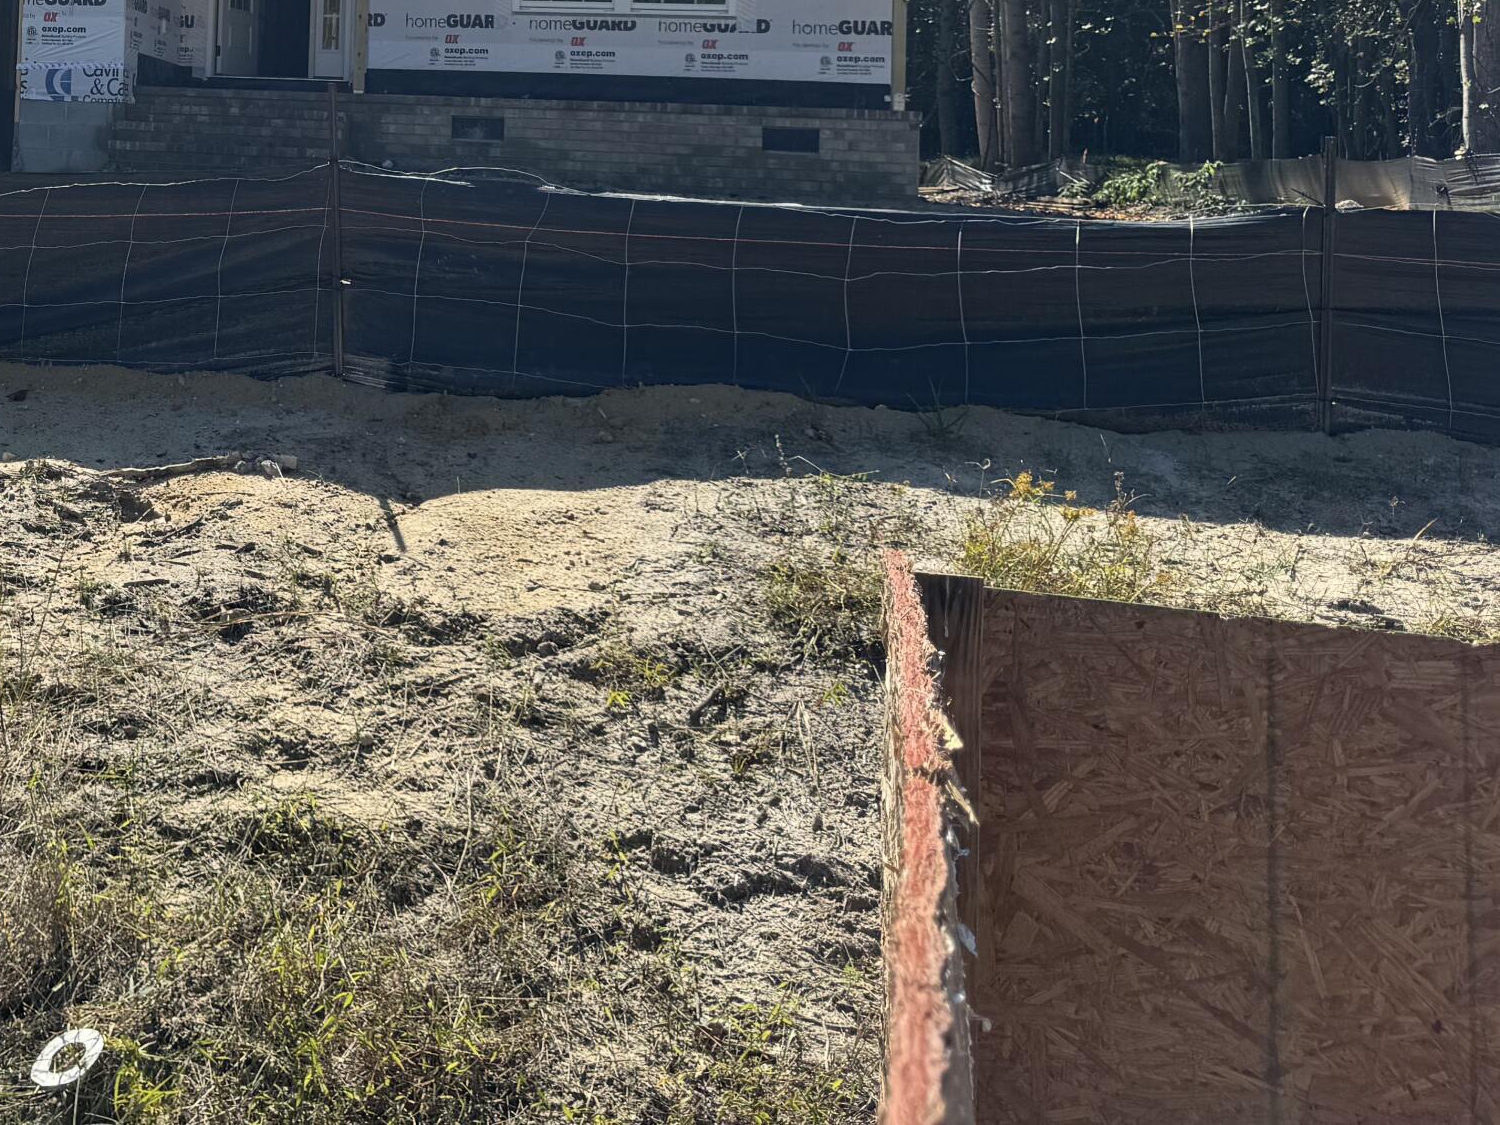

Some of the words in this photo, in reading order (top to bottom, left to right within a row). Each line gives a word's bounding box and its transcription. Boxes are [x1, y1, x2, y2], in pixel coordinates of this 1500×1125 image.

[41, 26, 87, 34] oxep.com
[444, 47, 489, 55] oxep.com
[570, 50, 615, 58] oxep.com
[700, 53, 749, 61] oxep.com
[836, 56, 885, 64] oxep.com
[90, 78, 105, 95] &
